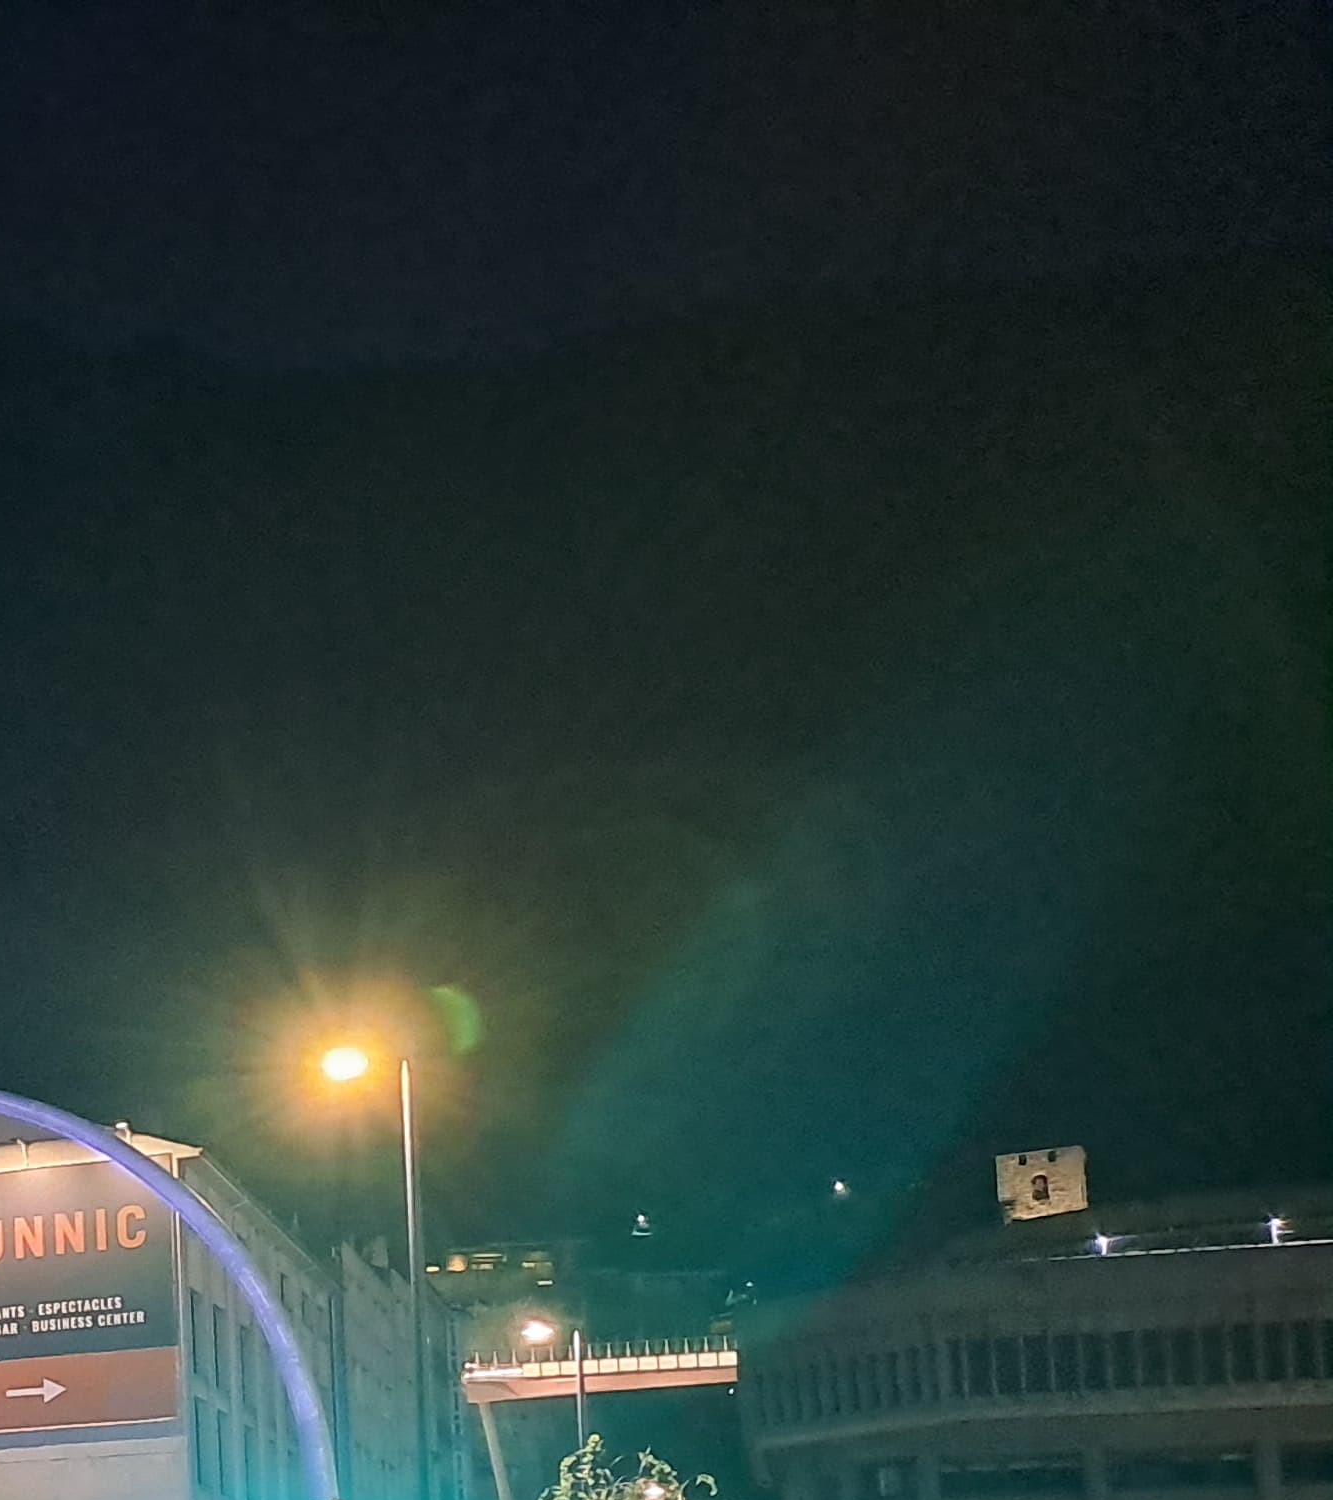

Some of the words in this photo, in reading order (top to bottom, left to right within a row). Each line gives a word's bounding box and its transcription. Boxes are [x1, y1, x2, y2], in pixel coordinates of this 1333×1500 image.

[38, 1296, 122, 1316] ESPECTACLES
[32, 1315, 93, 1333] BUSINESS
[97, 1310, 145, 1327] CENTER
